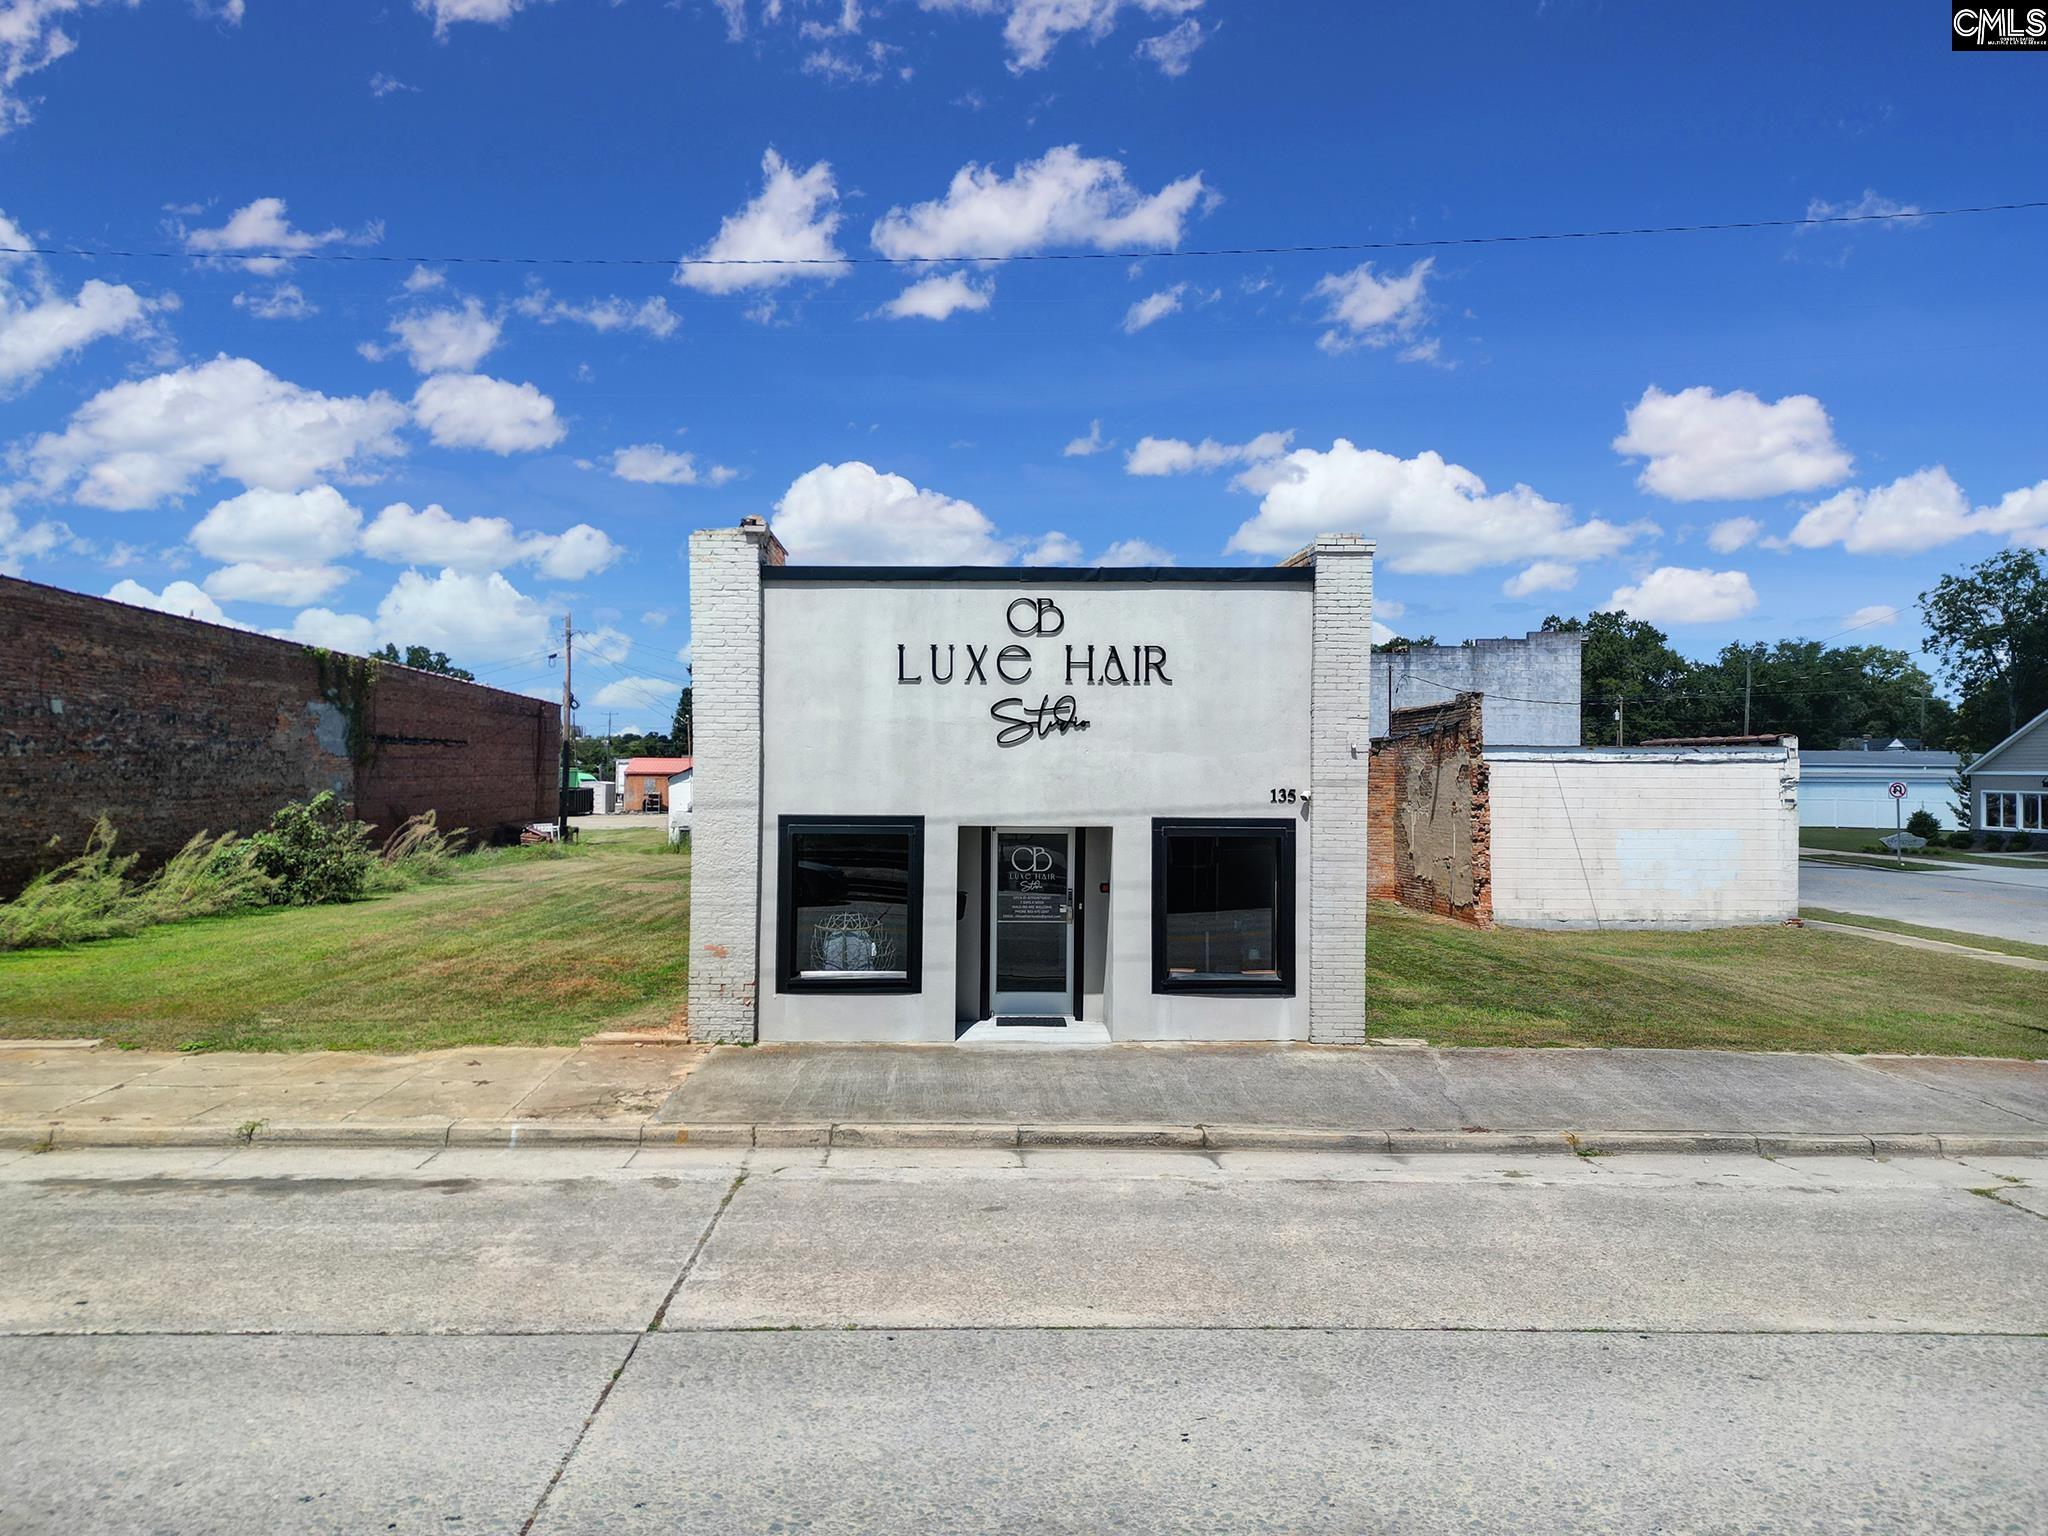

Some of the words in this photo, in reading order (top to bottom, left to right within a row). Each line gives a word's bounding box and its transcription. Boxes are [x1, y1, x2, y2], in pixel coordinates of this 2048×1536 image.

[1065, 644, 1172, 686] HAIR
[990, 694, 1090, 748] Studio
[1270, 788, 1297, 805] 135
